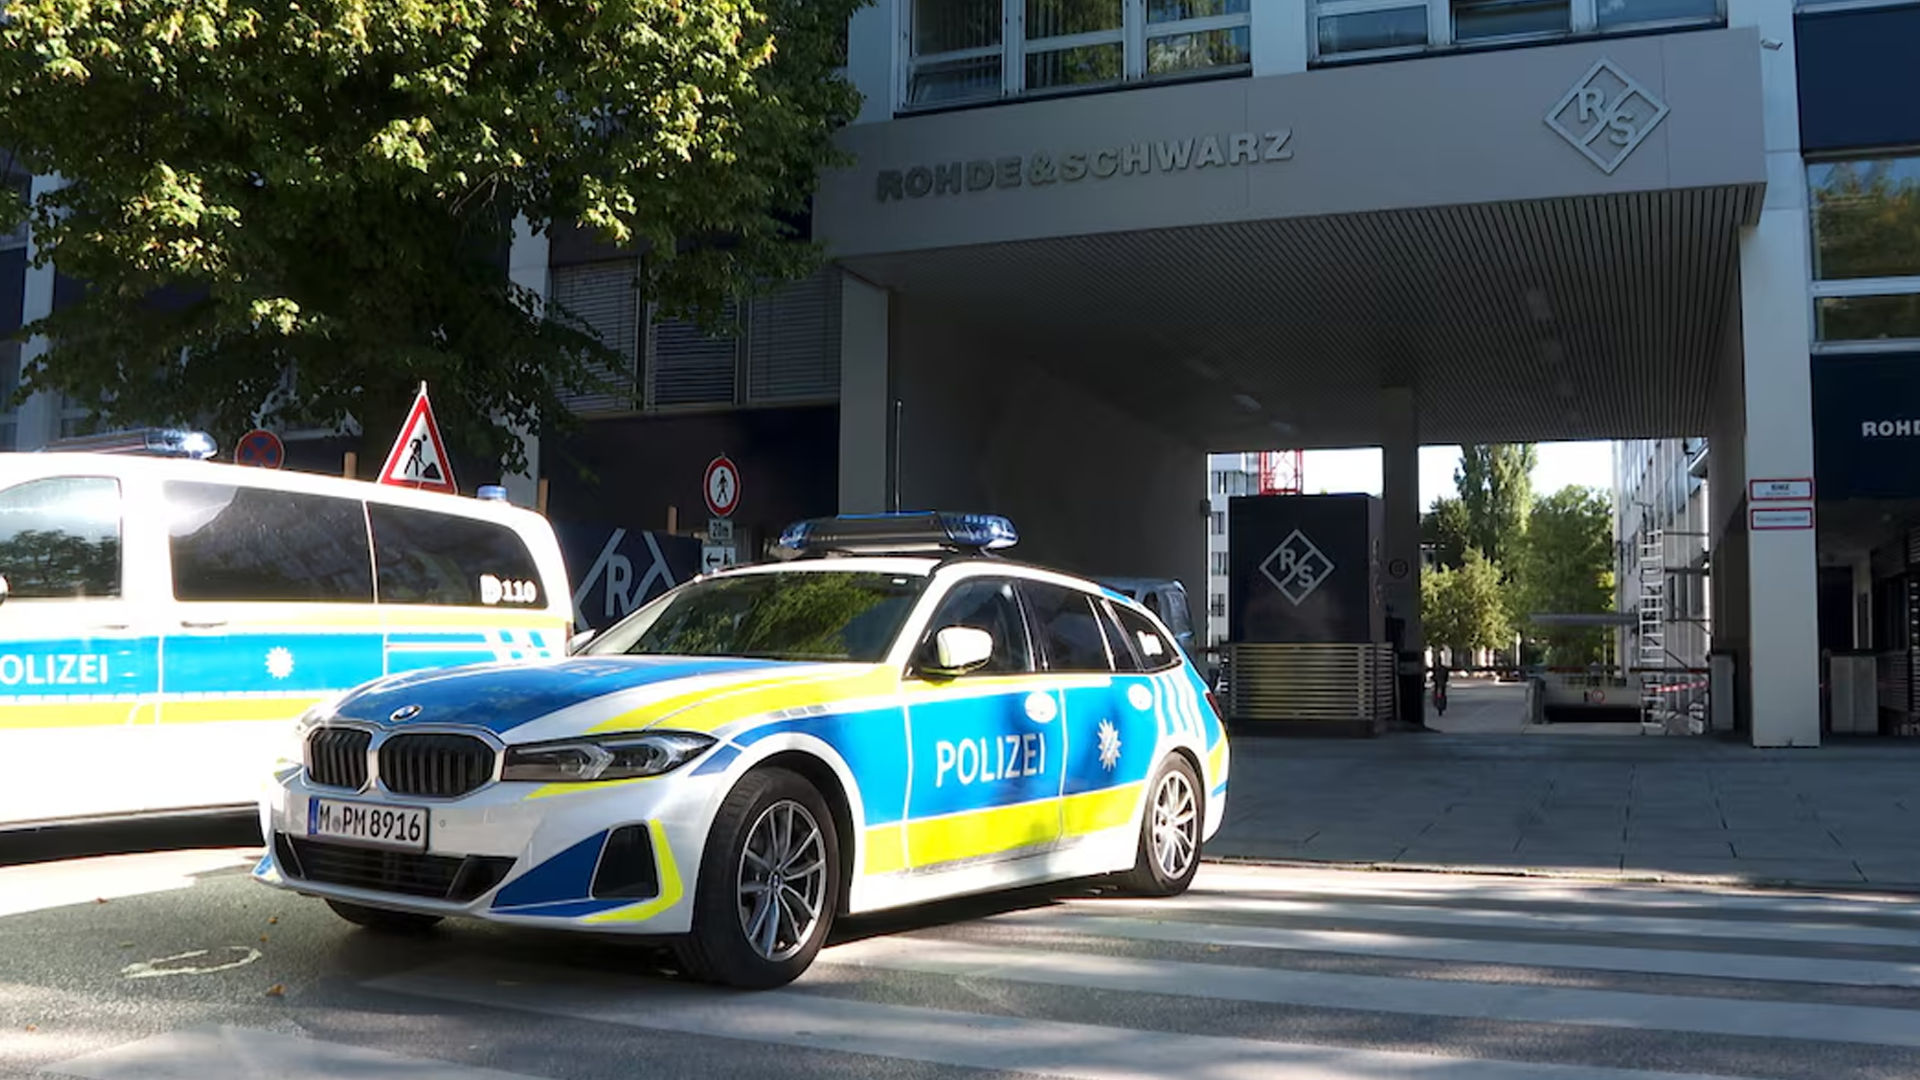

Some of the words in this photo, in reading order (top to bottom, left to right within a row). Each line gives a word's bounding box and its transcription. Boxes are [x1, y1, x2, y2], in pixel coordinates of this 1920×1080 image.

[502, 580, 536, 603] 110
[936, 733, 1045, 787] POLIZEI
[369, 809, 421, 842] 8916
